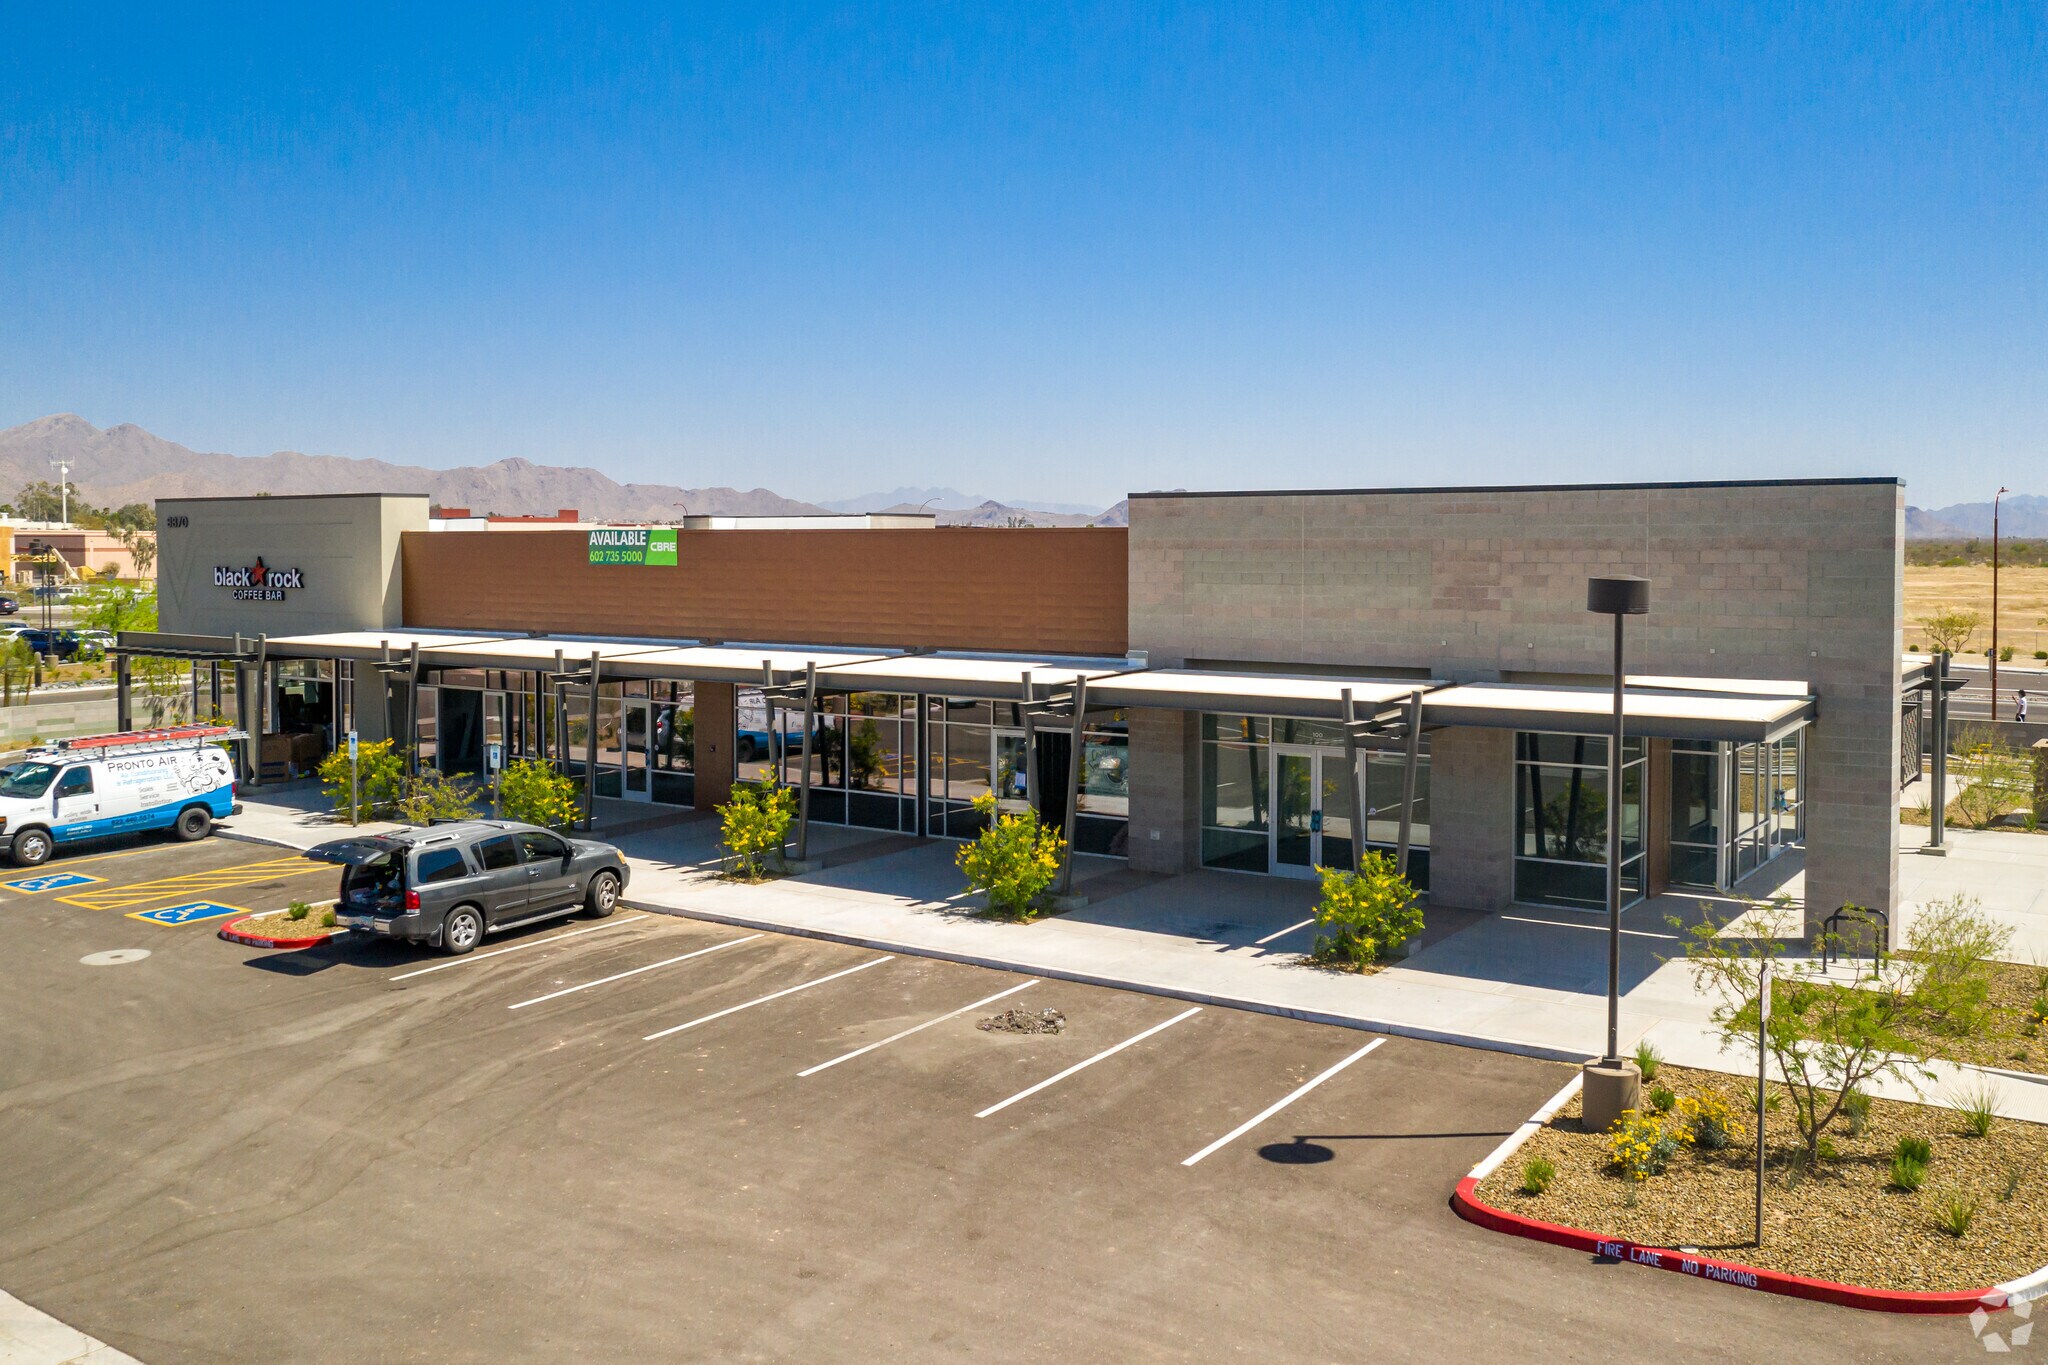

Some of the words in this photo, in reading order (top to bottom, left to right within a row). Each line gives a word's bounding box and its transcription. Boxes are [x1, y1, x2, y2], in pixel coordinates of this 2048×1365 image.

[589, 531, 647, 546] AVAILABLE
[650, 541, 677, 552] CBRE
[589, 551, 604, 562] 602
[605, 551, 620, 562] 735
[621, 551, 643, 562] 5000
[214, 566, 252, 586] black
[268, 568, 303, 588] rock
[232, 590, 263, 600] COFFEE
[265, 590, 284, 600] BAR
[1596, 1241, 1624, 1259] FIRE
[1629, 1247, 1663, 1268] LANE
[1681, 1258, 1699, 1275] NO
[1705, 1264, 1758, 1288] PARKING
